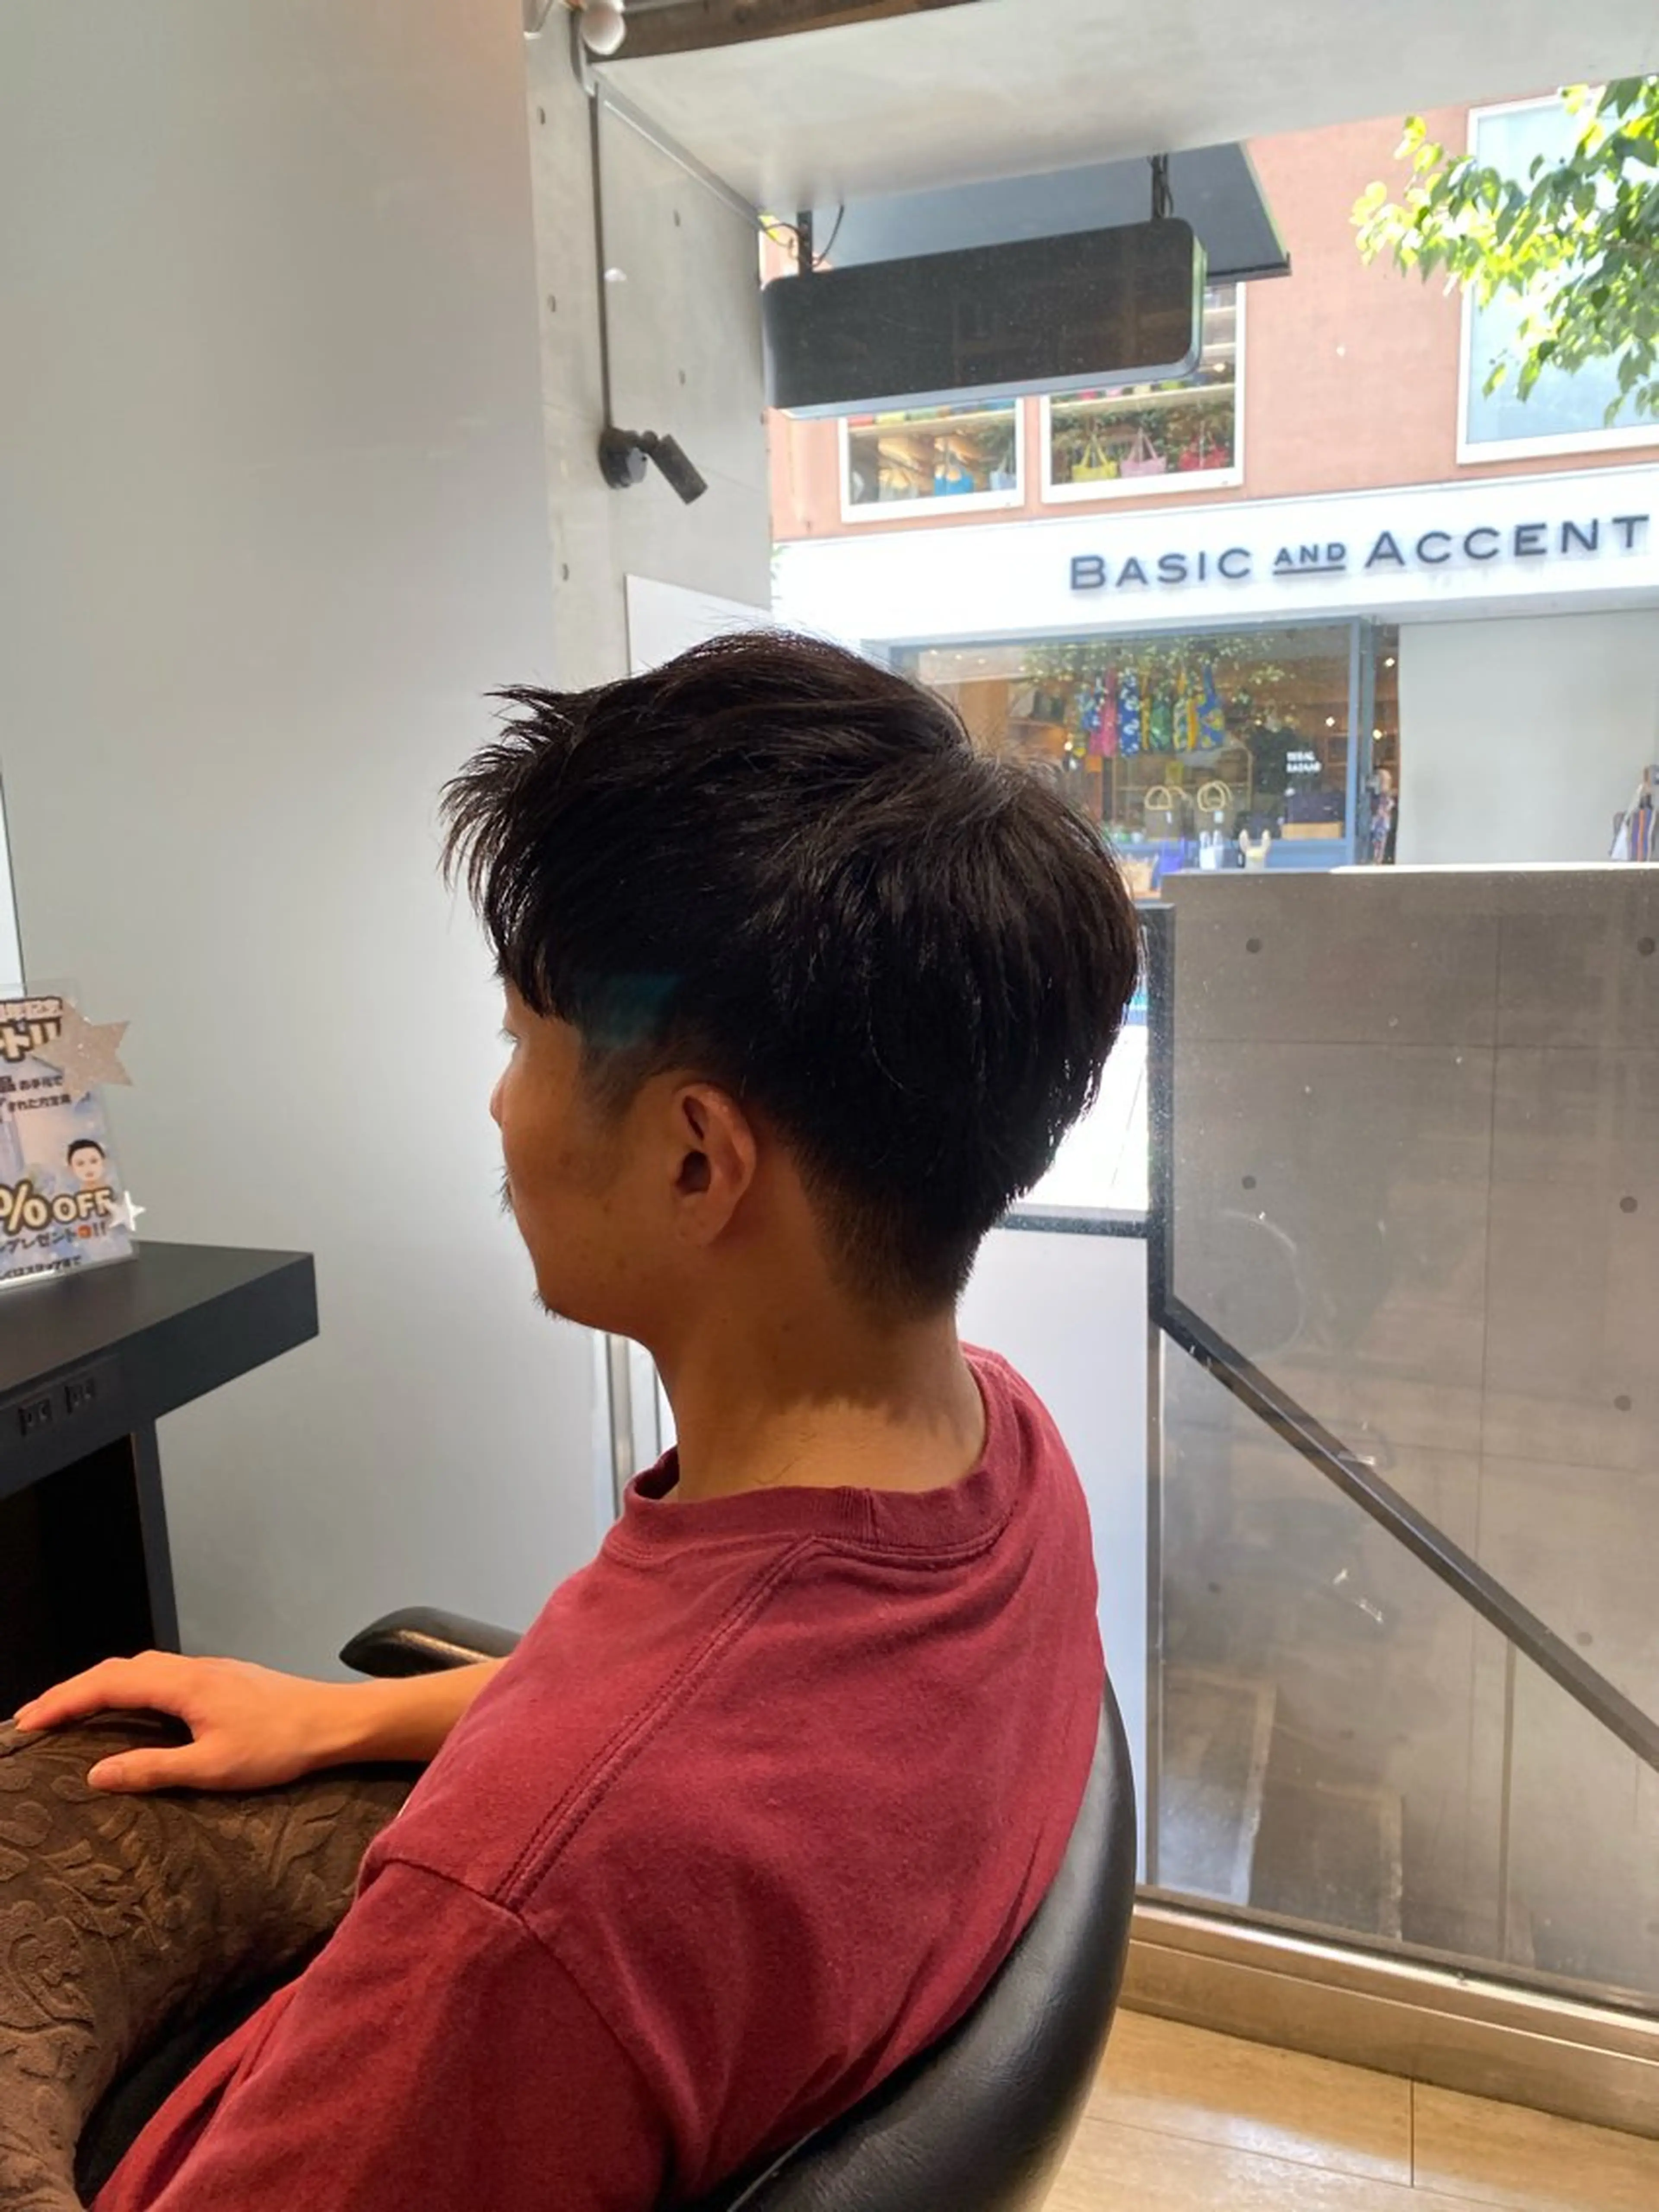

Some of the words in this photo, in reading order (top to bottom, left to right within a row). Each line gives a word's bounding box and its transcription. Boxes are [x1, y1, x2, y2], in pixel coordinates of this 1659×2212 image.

[1070, 548, 1251, 590] BASIC
[1273, 543, 1347, 568] AND
[1364, 514, 1650, 569] ACCENT
